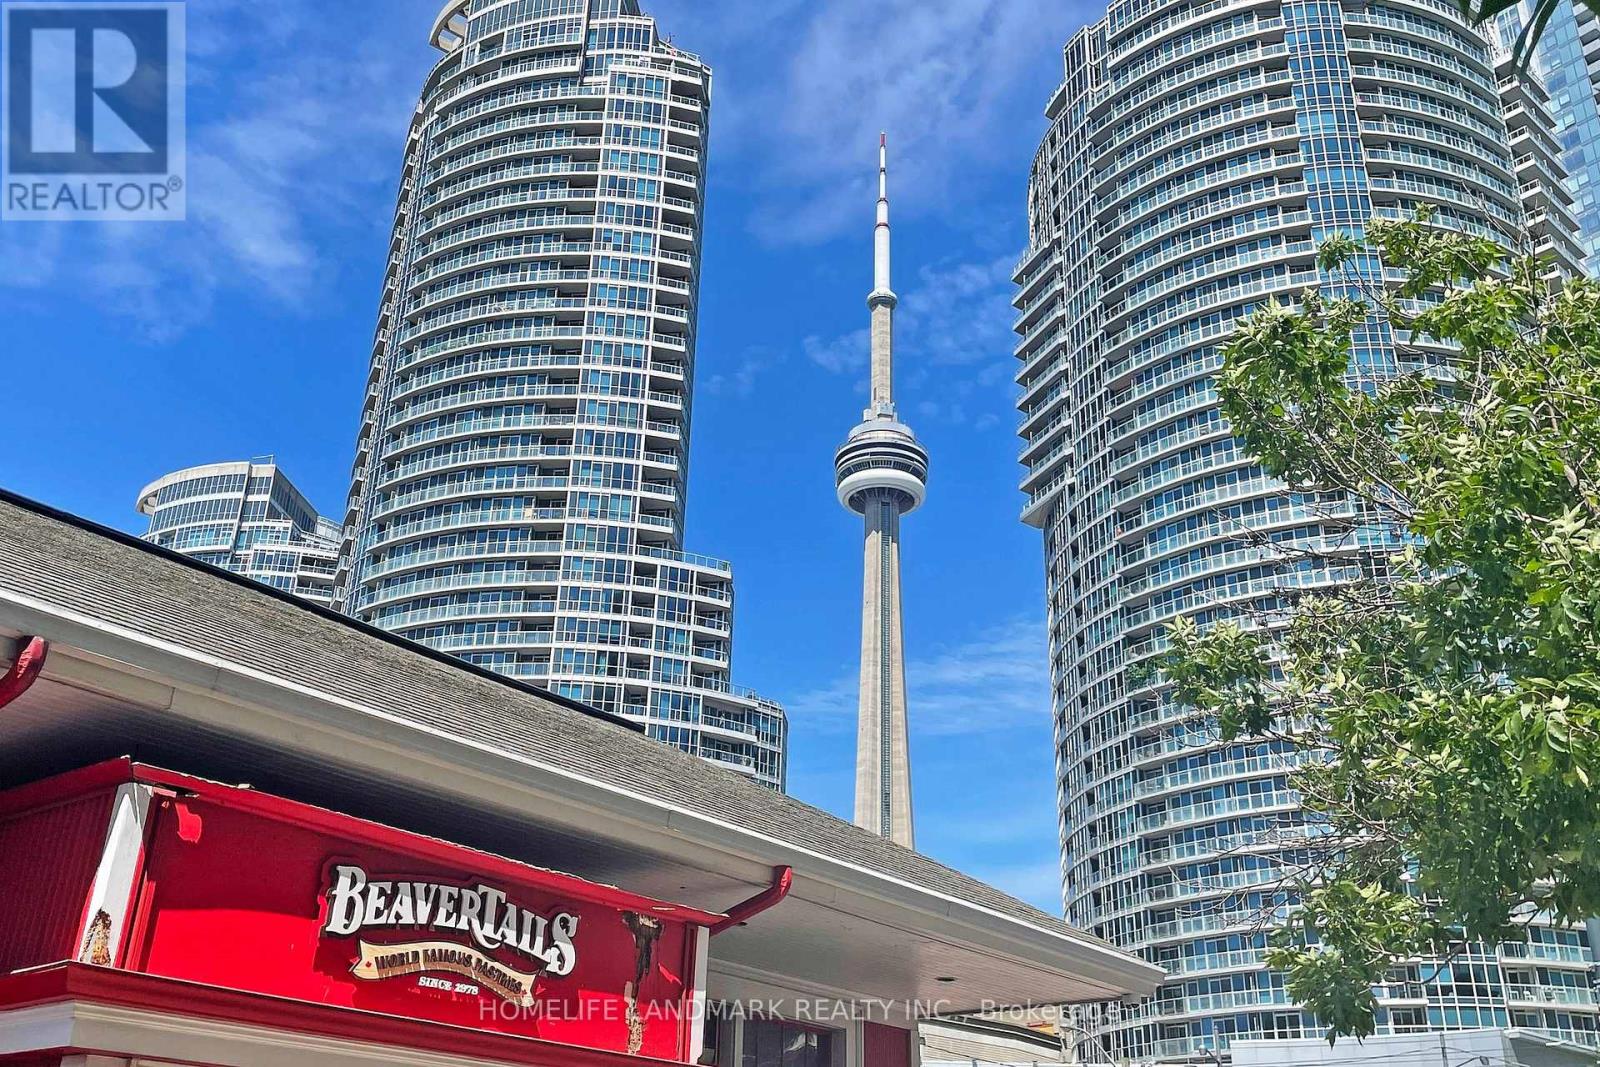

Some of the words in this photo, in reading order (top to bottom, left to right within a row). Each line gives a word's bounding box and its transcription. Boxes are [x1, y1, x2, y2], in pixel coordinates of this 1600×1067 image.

[325, 865, 577, 976] BEAVERTAILS
[374, 950, 420, 970] WORLD
[422, 948, 473, 969] FAMOUS
[473, 957, 523, 995] PASTRIES
[418, 976, 453, 991] SINCE
